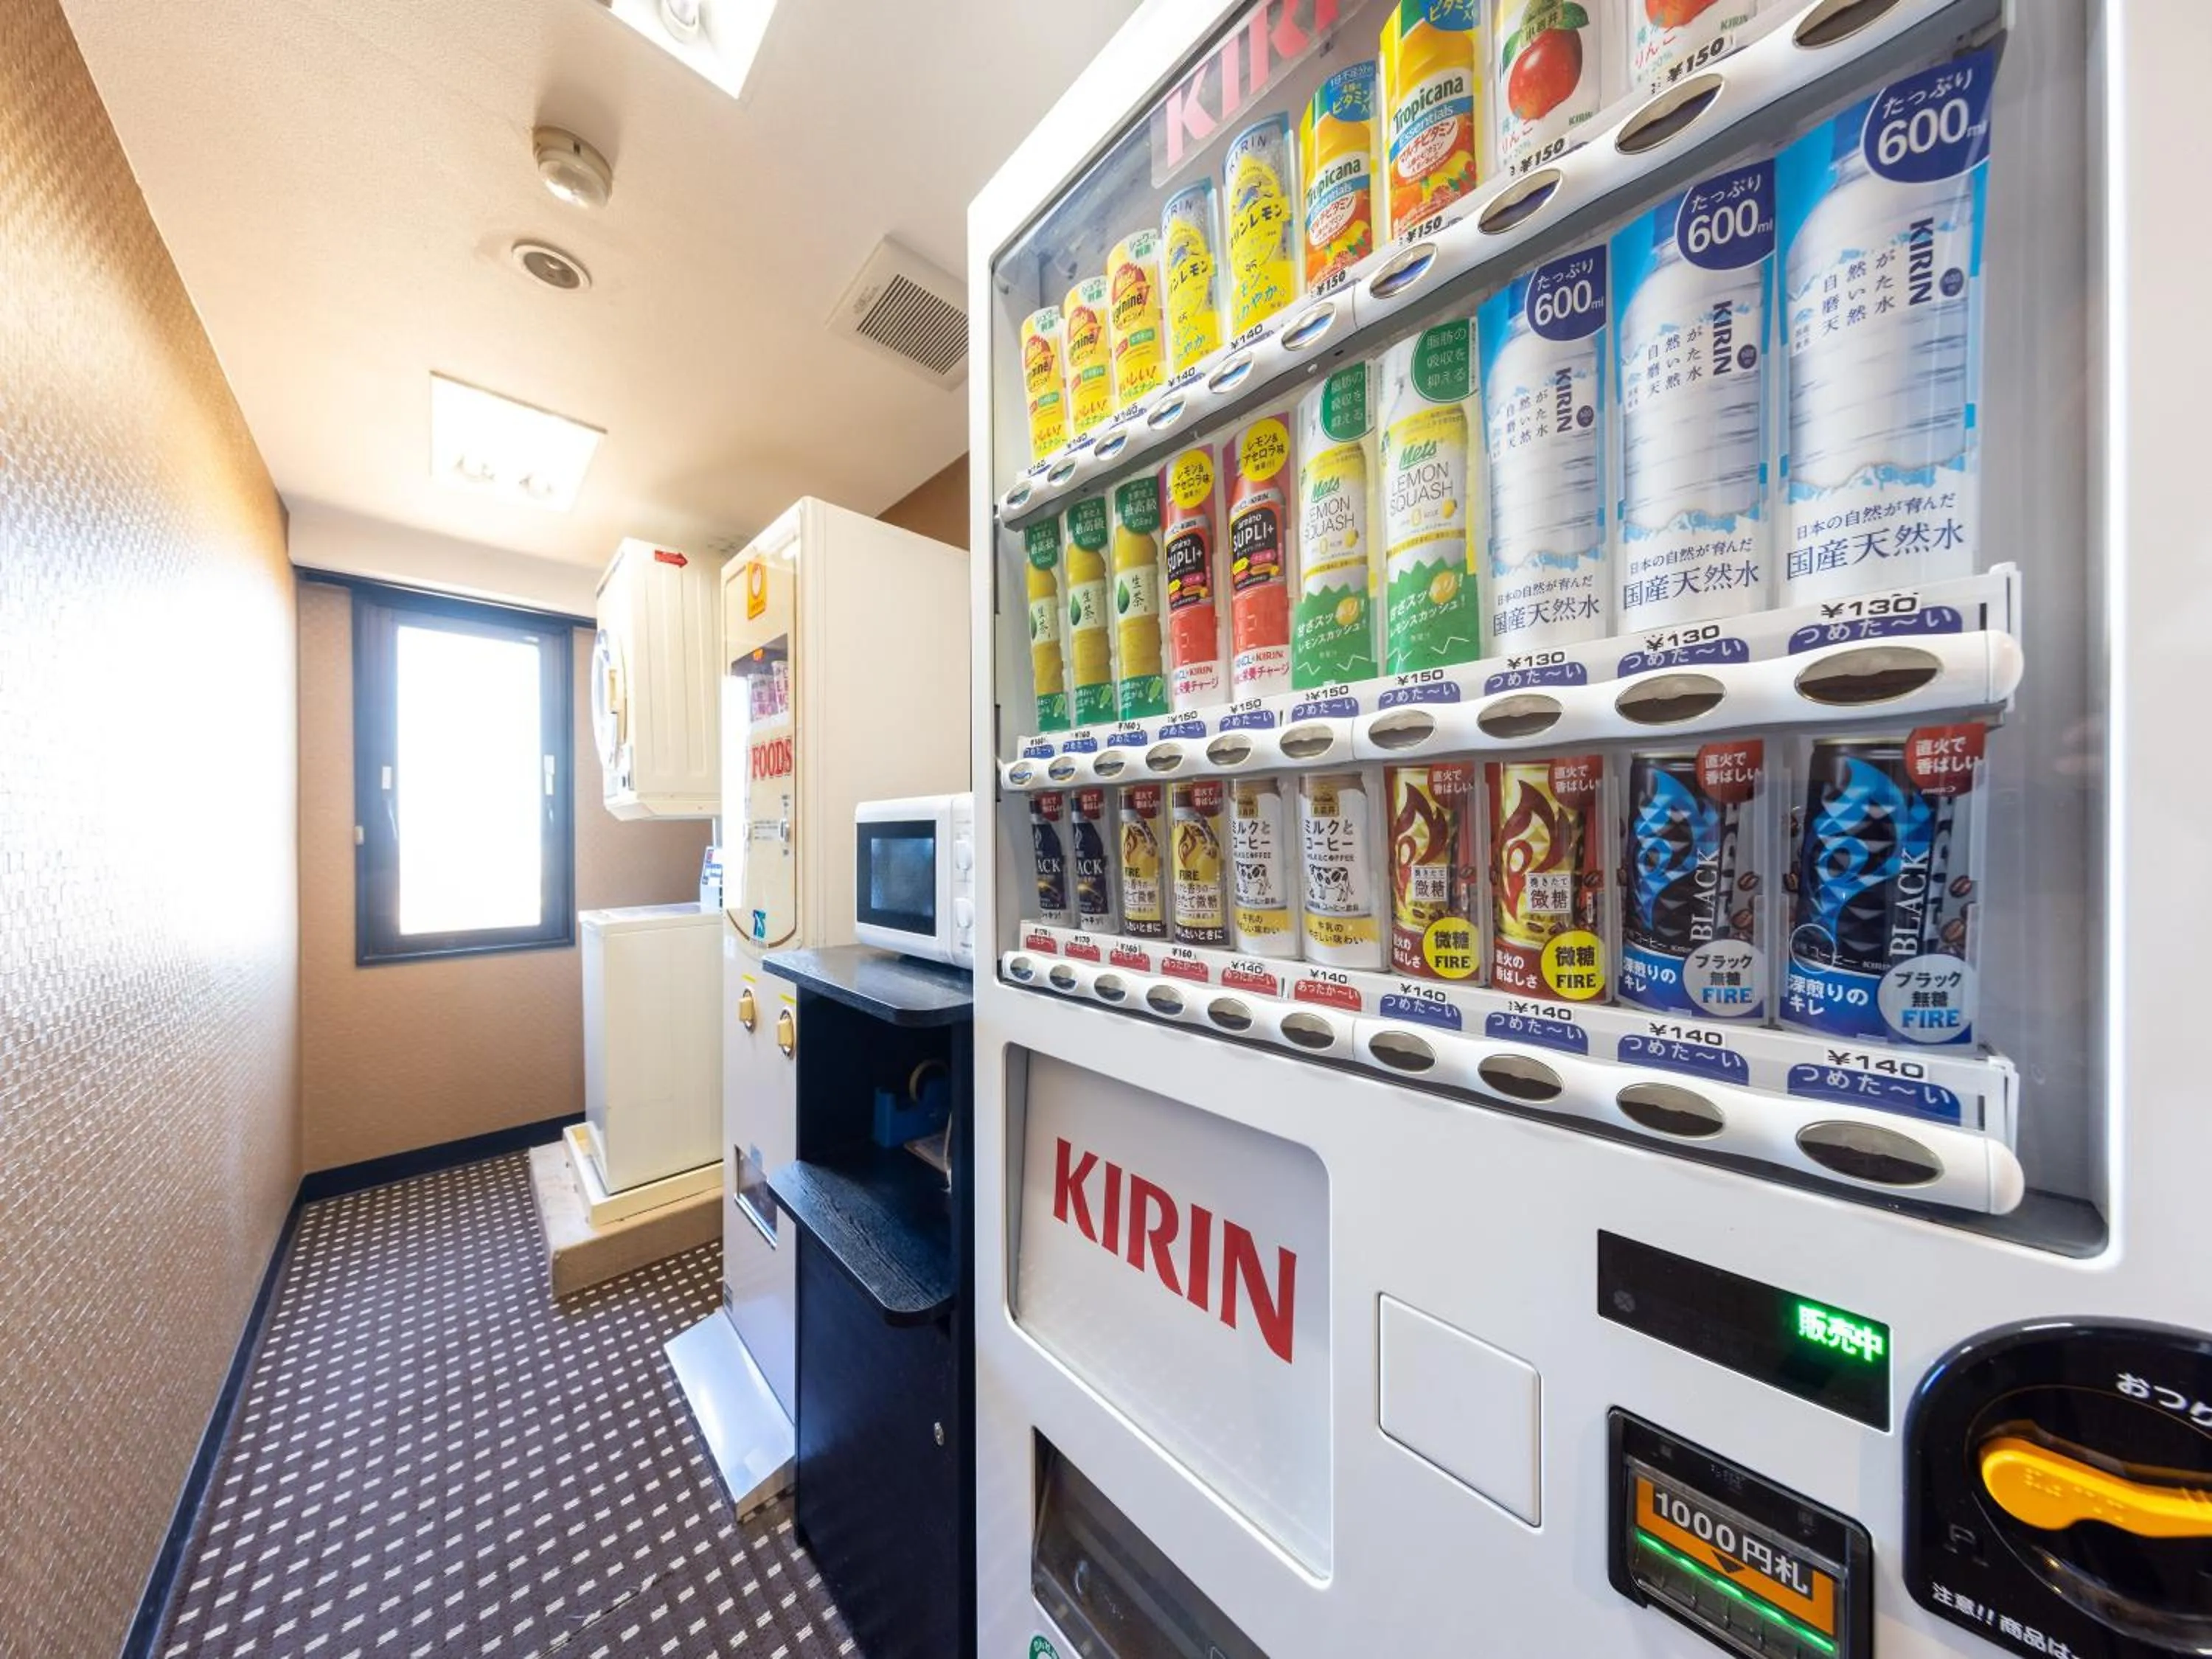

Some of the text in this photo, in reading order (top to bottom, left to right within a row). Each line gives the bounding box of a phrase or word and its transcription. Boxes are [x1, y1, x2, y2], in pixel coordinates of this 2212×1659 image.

[1720, 15, 1748, 30] KIRIN
[1667, 37, 1725, 83] ¥150
[1393, 76, 1464, 134] Tropicana
[1881, 68, 1973, 119] たっぷり
[1877, 98, 1988, 166] 600ml
[1520, 138, 1565, 173] ¥150
[1691, 173, 1761, 212] たっぷり
[1406, 215, 1443, 244] ¥150
[1687, 198, 1774, 254] 600ml
[1823, 249, 1896, 293] 自然が
[1908, 217, 1935, 307] KIRIN
[1316, 270, 1346, 296] ¥150
[1537, 258, 1594, 291] たっぷり
[1534, 279, 1605, 327] 600ml
[1822, 295, 1895, 337] 天然水
[1231, 324, 1264, 349] ¥140
[1713, 299, 1733, 376] KIRIN
[1427, 349, 1466, 368] 吸収を
[1167, 366, 1196, 388] ¥140
[1427, 368, 1466, 389] 抑える
[1556, 366, 1573, 434] KIRIN
[1399, 440, 1437, 468] Mets
[1392, 461, 1450, 497] LEMON
[1389, 480, 1454, 517] SQUASH
[1795, 492, 1957, 541] 日本の自然が育んだ
[1234, 521, 1274, 553] SUPLI+
[1630, 537, 1753, 575] 日本の自然が育んだ
[1786, 518, 1965, 581] 国産天然水
[1497, 574, 1593, 607] 日本の自然が育んだ
[1622, 559, 1759, 611] 国産天然水
[1493, 594, 1601, 637] 国産天然水
[1820, 594, 1917, 619] ¥130
[1645, 624, 1721, 652] ¥130
[1506, 650, 1565, 670] ¥130
[1397, 668, 1444, 686] ¥150
[1310, 684, 1349, 700] ¥150
[1230, 699, 1262, 714] ¥150
[1915, 736, 1968, 757] 直火で
[751, 739, 793, 779] FOODS
[1704, 751, 1747, 769] 直火で
[1915, 755, 1983, 776] 香ばしい
[1554, 765, 1589, 781] 直火で
[1554, 777, 1601, 793] 香ばしい
[1704, 767, 1763, 785] 香ばしい
[1232, 819, 1271, 835] ミルクと
[1304, 818, 1354, 836] ミルクと
[1234, 838, 1271, 850] コーヒー
[1306, 837, 1354, 852] コーヒー
[1415, 880, 1445, 897] 微糖
[1529, 888, 1569, 910] 微糖
[1689, 848, 1721, 942] BLACK
[1888, 846, 1930, 957] BLACK
[1172, 947, 1193, 958] ¥160
[1434, 955, 1471, 969] FIRE
[1555, 945, 1596, 968] 微糖
[1696, 953, 1753, 970] ブラック
[1230, 961, 1264, 975] ¥140
[1309, 968, 1348, 984] ¥140
[1710, 971, 1742, 987] 無糖
[1894, 970, 1963, 989] ブラック
[1401, 983, 1447, 1003] ¥140
[1556, 973, 1596, 990] FIRE
[1624, 974, 1646, 992] キレ
[1788, 974, 1869, 1006] 深煎りの
[1701, 986, 1753, 1005] FIRE
[1789, 994, 1825, 1016] キレ
[1911, 990, 1949, 1008] 無糖
[1513, 1001, 1573, 1021] ¥140
[1901, 1009, 1961, 1029] FIRE
[1648, 1023, 1723, 1047] ¥140
[1826, 1048, 1925, 1079] ¥140
[1052, 1135, 1298, 1366] KIRIN
[1798, 1304, 1883, 1362] 販売中
[1655, 1492, 1809, 1594] 1000円札
